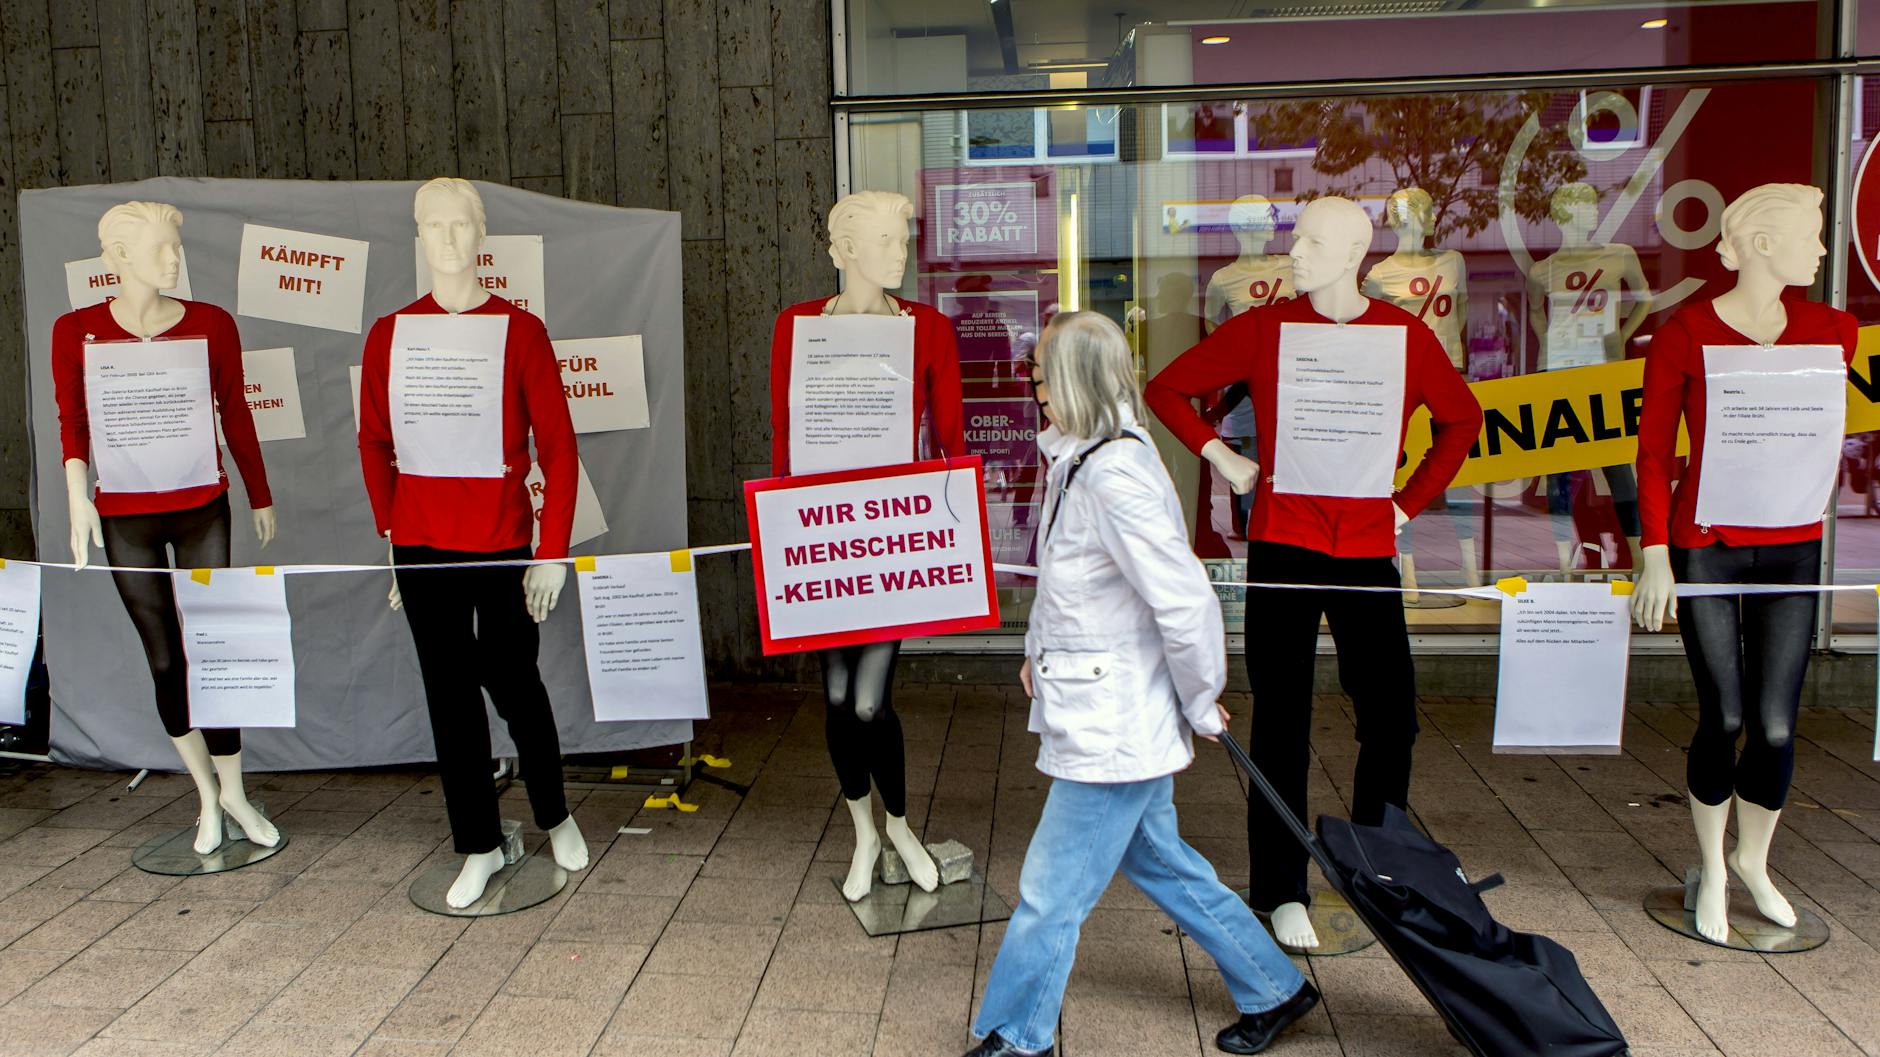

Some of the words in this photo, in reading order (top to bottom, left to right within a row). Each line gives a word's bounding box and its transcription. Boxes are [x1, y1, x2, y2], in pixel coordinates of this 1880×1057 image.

[953, 201, 1017, 225] 30%
[260, 245, 345, 271] KÄMPFT
[476, 254, 493, 266] IR
[279, 275, 322, 295] MIT!
[558, 355, 598, 373] FÜR
[244, 383, 262, 393] EN
[562, 381, 614, 399] RÜHL
[247, 398, 284, 411] EHEN!
[970, 415, 1014, 428] OBER-
[963, 429, 1036, 443] KLEIDUNG
[798, 502, 856, 528] WIR
[864, 494, 932, 521] SIND
[784, 528, 956, 567] MENSCHEN!
[775, 574, 875, 604] -KEINE
[880, 563, 974, 593] WARE!
